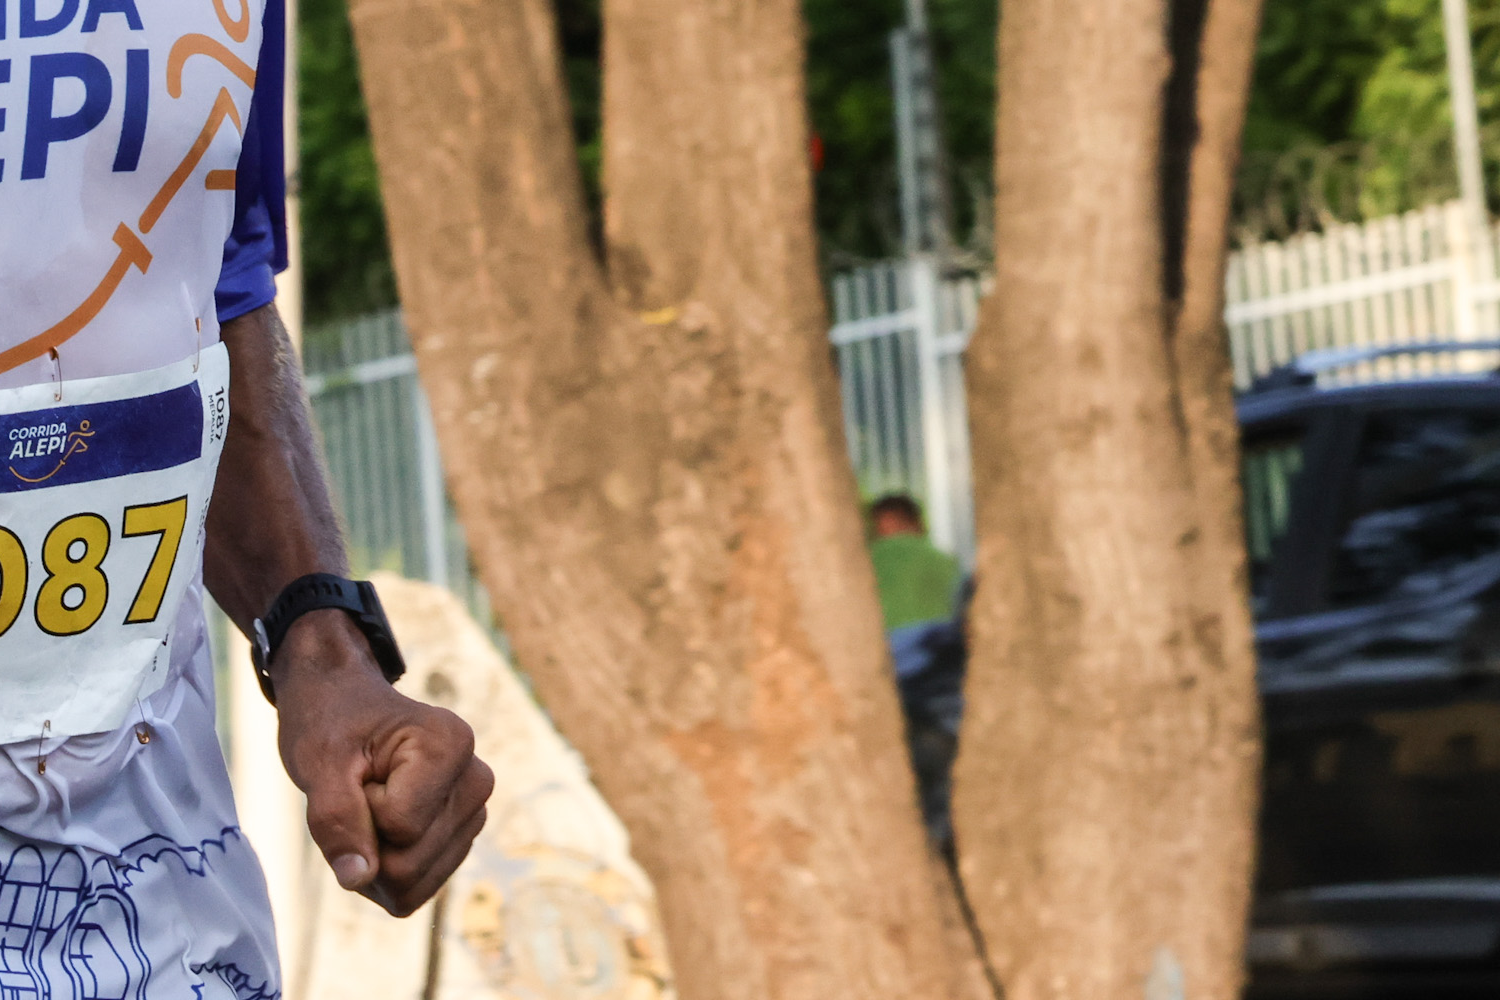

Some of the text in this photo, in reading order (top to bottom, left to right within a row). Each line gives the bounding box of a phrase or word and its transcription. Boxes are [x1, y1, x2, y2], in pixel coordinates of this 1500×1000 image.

[215, 385, 225, 441] 1087
[8, 422, 68, 441] CORRIDA
[8, 435, 67, 460] ALEPI
